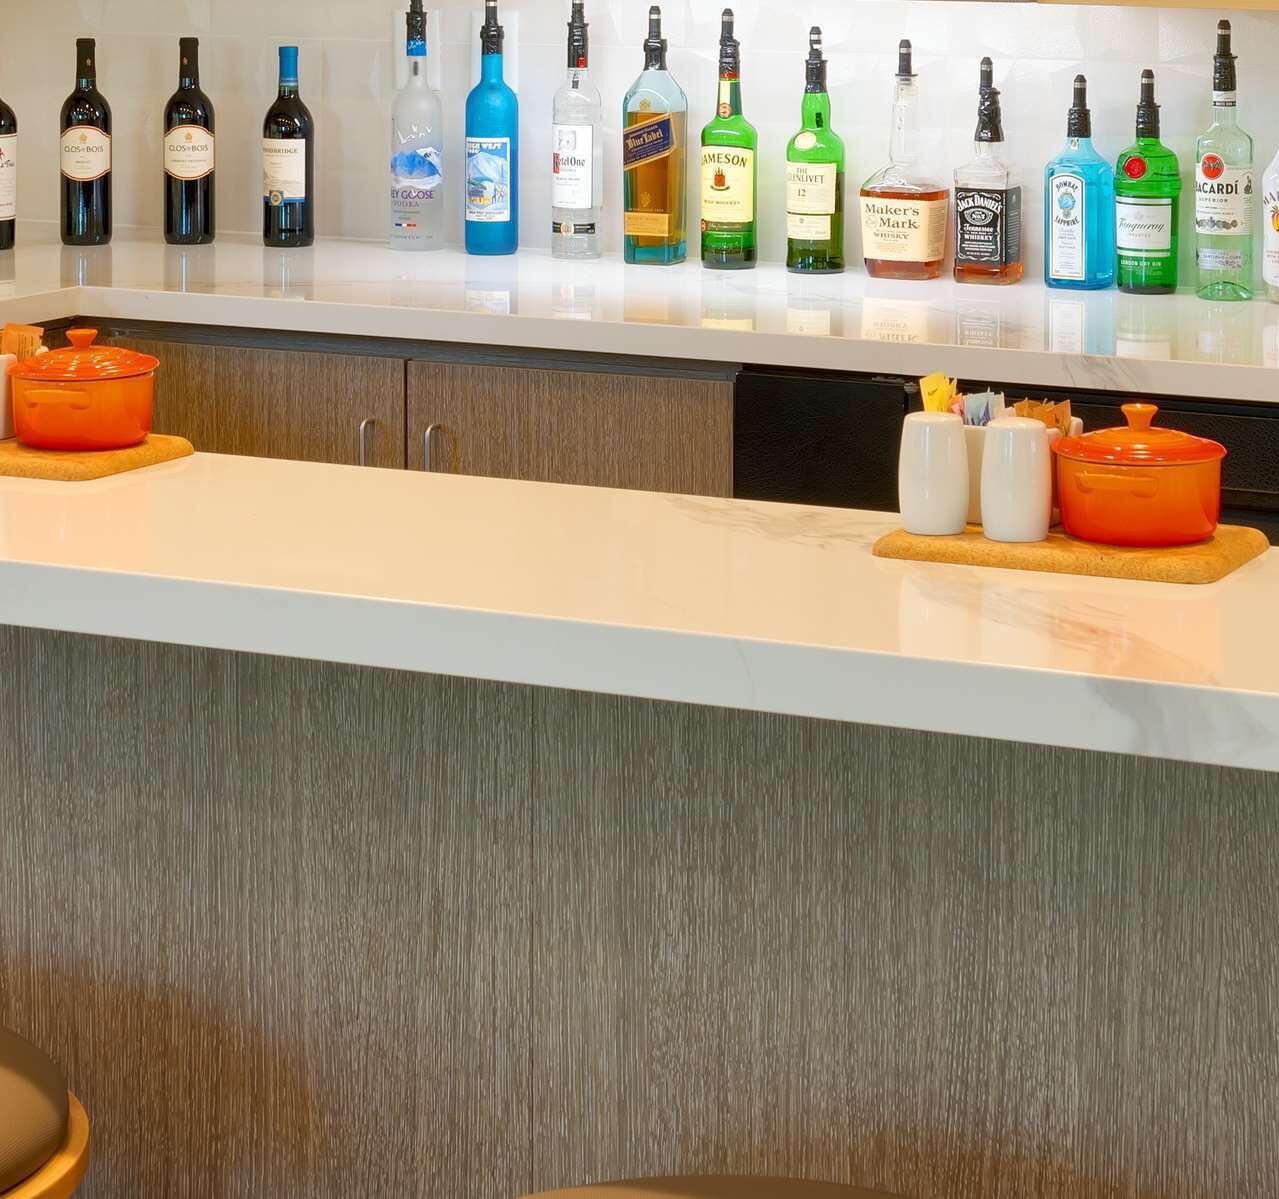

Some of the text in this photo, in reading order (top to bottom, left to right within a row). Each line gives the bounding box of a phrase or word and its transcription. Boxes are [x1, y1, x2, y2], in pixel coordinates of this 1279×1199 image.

[570, 156, 586, 167] One
[798, 189, 807, 197] 12
[1055, 180, 1079, 193] BOMBAY
[401, 190, 434, 200] GOOSE
[865, 203, 920, 216] Maker's
[957, 196, 975, 212] JACK
[879, 217, 920, 230] Mark
[1119, 217, 1166, 233] Tanqueray
